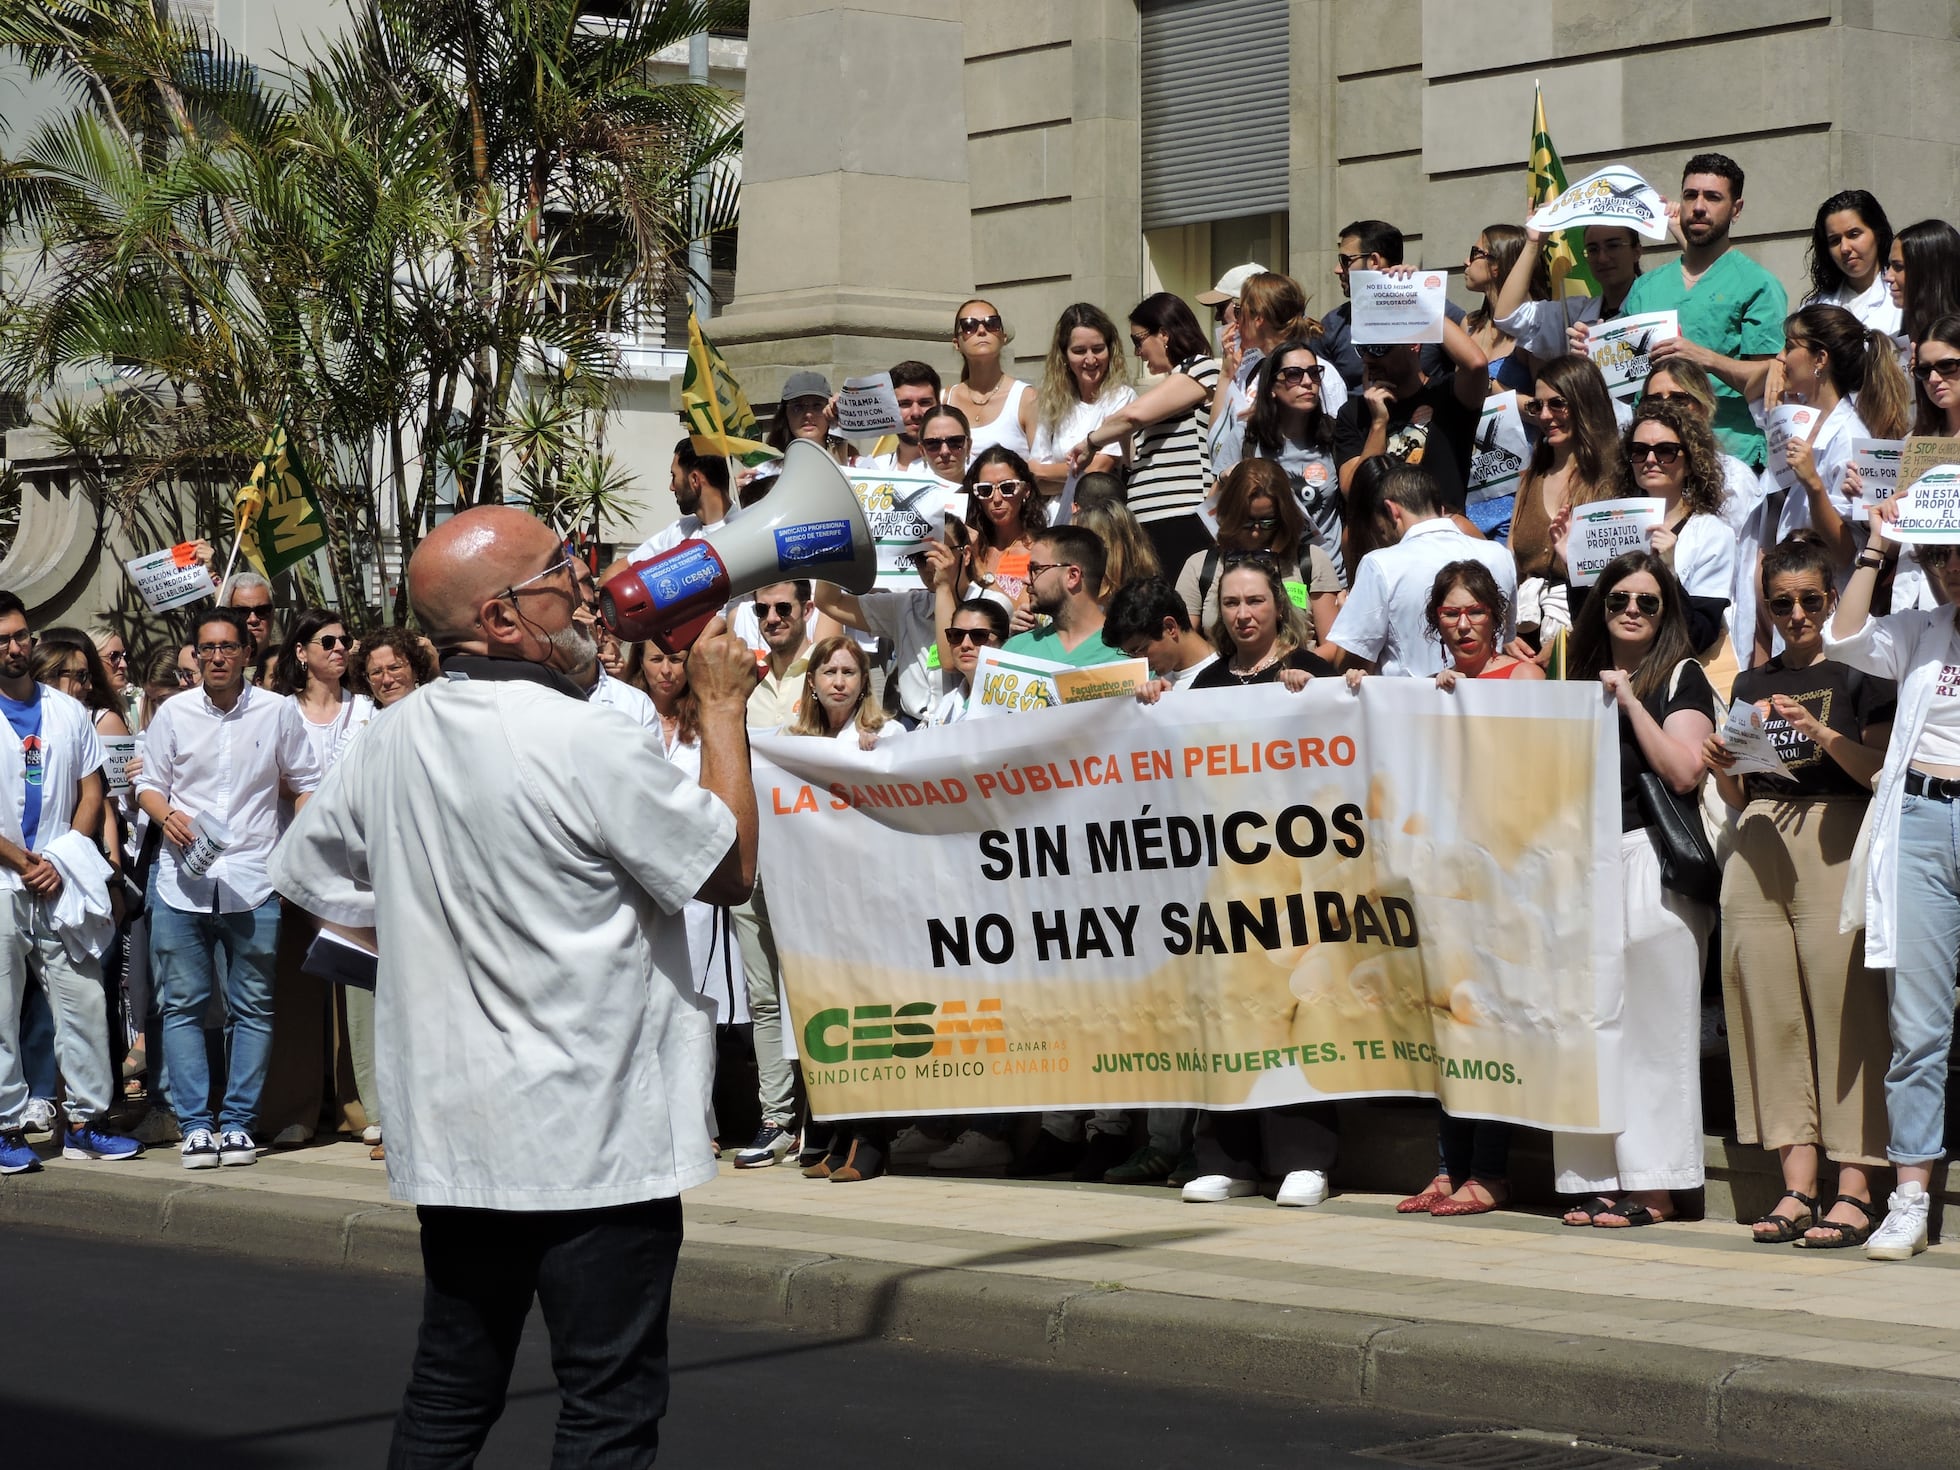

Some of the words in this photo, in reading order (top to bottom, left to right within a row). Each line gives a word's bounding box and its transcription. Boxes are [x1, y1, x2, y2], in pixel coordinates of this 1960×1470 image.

[1573, 198, 1639, 209] ESTATUTO
[1615, 354, 1649, 371] ESTATU
[1629, 363, 1652, 377] MAR
[869, 408, 883, 416] CON
[1914, 442, 1937, 454] STOP
[1471, 449, 1504, 468] ATUTO
[1880, 468, 1897, 477] POR
[1876, 488, 1888, 499] DE
[1915, 490, 1930, 499] UN
[1932, 489, 1960, 499] ESTA
[858, 495, 894, 511] EVO
[1915, 499, 1955, 509] PROPIO
[865, 511, 916, 523] TATUTO
[1942, 509, 1954, 518] EL
[779, 525, 808, 537] SINDICATO
[808, 521, 846, 531] PROFESIONAL
[1894, 516, 1960, 529] MÉDICO/FAC
[815, 529, 842, 538] TENERIFE
[873, 523, 929, 537] MARCO!
[1586, 529, 1596, 539] UN
[1598, 525, 1638, 538] ESTATUTO
[1587, 537, 1617, 549] PROPIO
[1619, 535, 1641, 546] PARA
[669, 547, 703, 564] PROFESIONAL
[1610, 547, 1620, 557] EL
[137, 570, 172, 587] APLICACIÓN
[144, 586, 153, 595] DE
[152, 582, 163, 593] LAS
[163, 574, 192, 589] MEDIDAS
[193, 570, 201, 578] DE
[156, 582, 193, 601] ESTABILIDAD
[1942, 665, 1960, 675] SU
[1071, 680, 1120, 696] Facultativo
[1122, 679, 1135, 687] en
[1938, 675, 1960, 686] UR
[1024, 679, 1050, 698] AL
[1936, 685, 1958, 697] RL
[982, 688, 1049, 712] NUEVO
[1763, 719, 1784, 731] THE
[1766, 729, 1809, 747] RSIO
[1779, 747, 1800, 760] YOU
[772, 785, 819, 815] LA
[829, 778, 968, 811] SANIDAD
[973, 754, 1123, 799] PÚBLICA
[1131, 749, 1173, 782] EN
[1183, 735, 1356, 777] PELIGRO
[979, 824, 1070, 882] SIN
[1085, 803, 1365, 874] MÉDICOS
[928, 912, 1015, 968] NO
[1032, 905, 1140, 961] HAY
[1160, 890, 1418, 957] SANIDAD
[804, 998, 1006, 1064] CESM
[1008, 1039, 1067, 1052] CANARIAS
[1092, 1052, 1172, 1073] JUNTOS
[1176, 1048, 1208, 1072] MÁS
[1212, 1041, 1346, 1073] FUERTES.
[1353, 1040, 1387, 1061] TE
[1392, 1040, 1523, 1085] NECETAMOS.
[808, 1065, 907, 1085] SINDICATO
[915, 1060, 985, 1079] MÉDICO
[992, 1057, 1070, 1076] CANARIO
